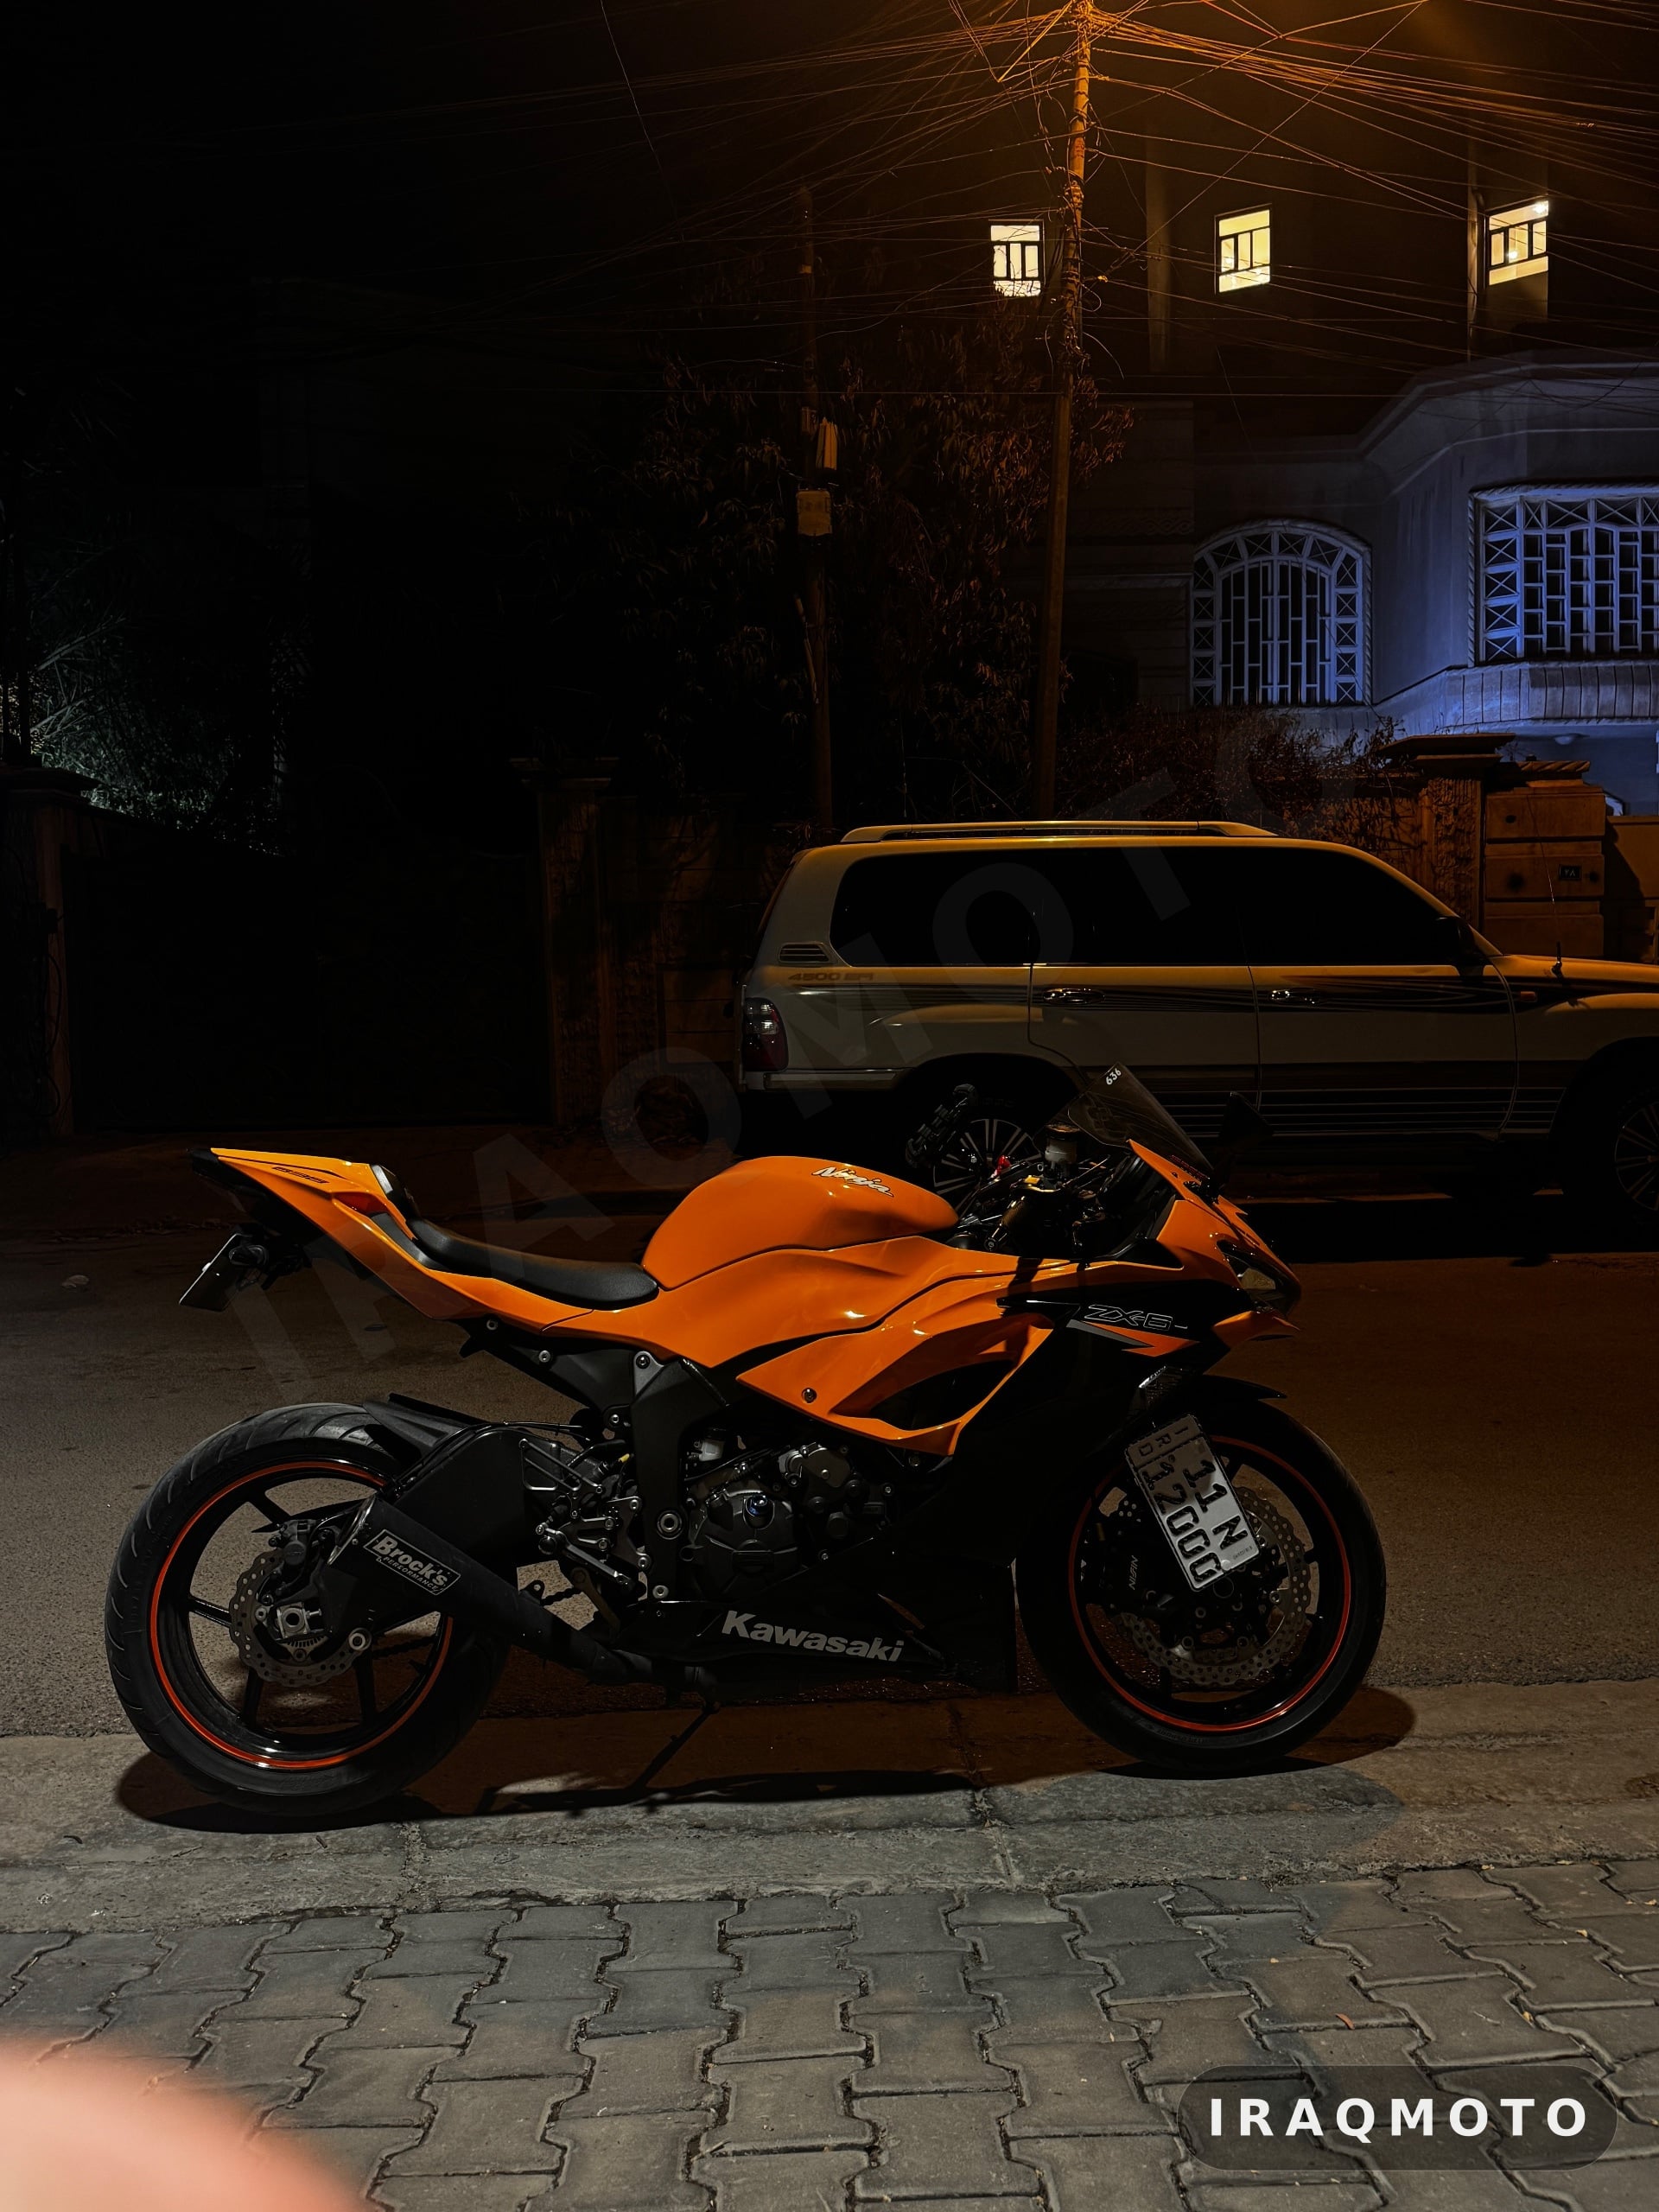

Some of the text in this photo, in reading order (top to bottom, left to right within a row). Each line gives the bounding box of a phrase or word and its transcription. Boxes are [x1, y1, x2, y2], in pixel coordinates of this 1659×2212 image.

[788, 972, 841, 981] 4500
[1106, 1068, 1122, 1085] 636
[811, 1166, 894, 1198] Ninja
[1141, 1461, 1222, 1583] 12000
[1182, 1459, 1227, 1514] 11
[1212, 1516, 1249, 1550] N
[372, 1535, 448, 1586] Brock's
[382, 1555, 442, 1592] PERFORMANCE
[721, 1610, 905, 1662] Kawasaki
